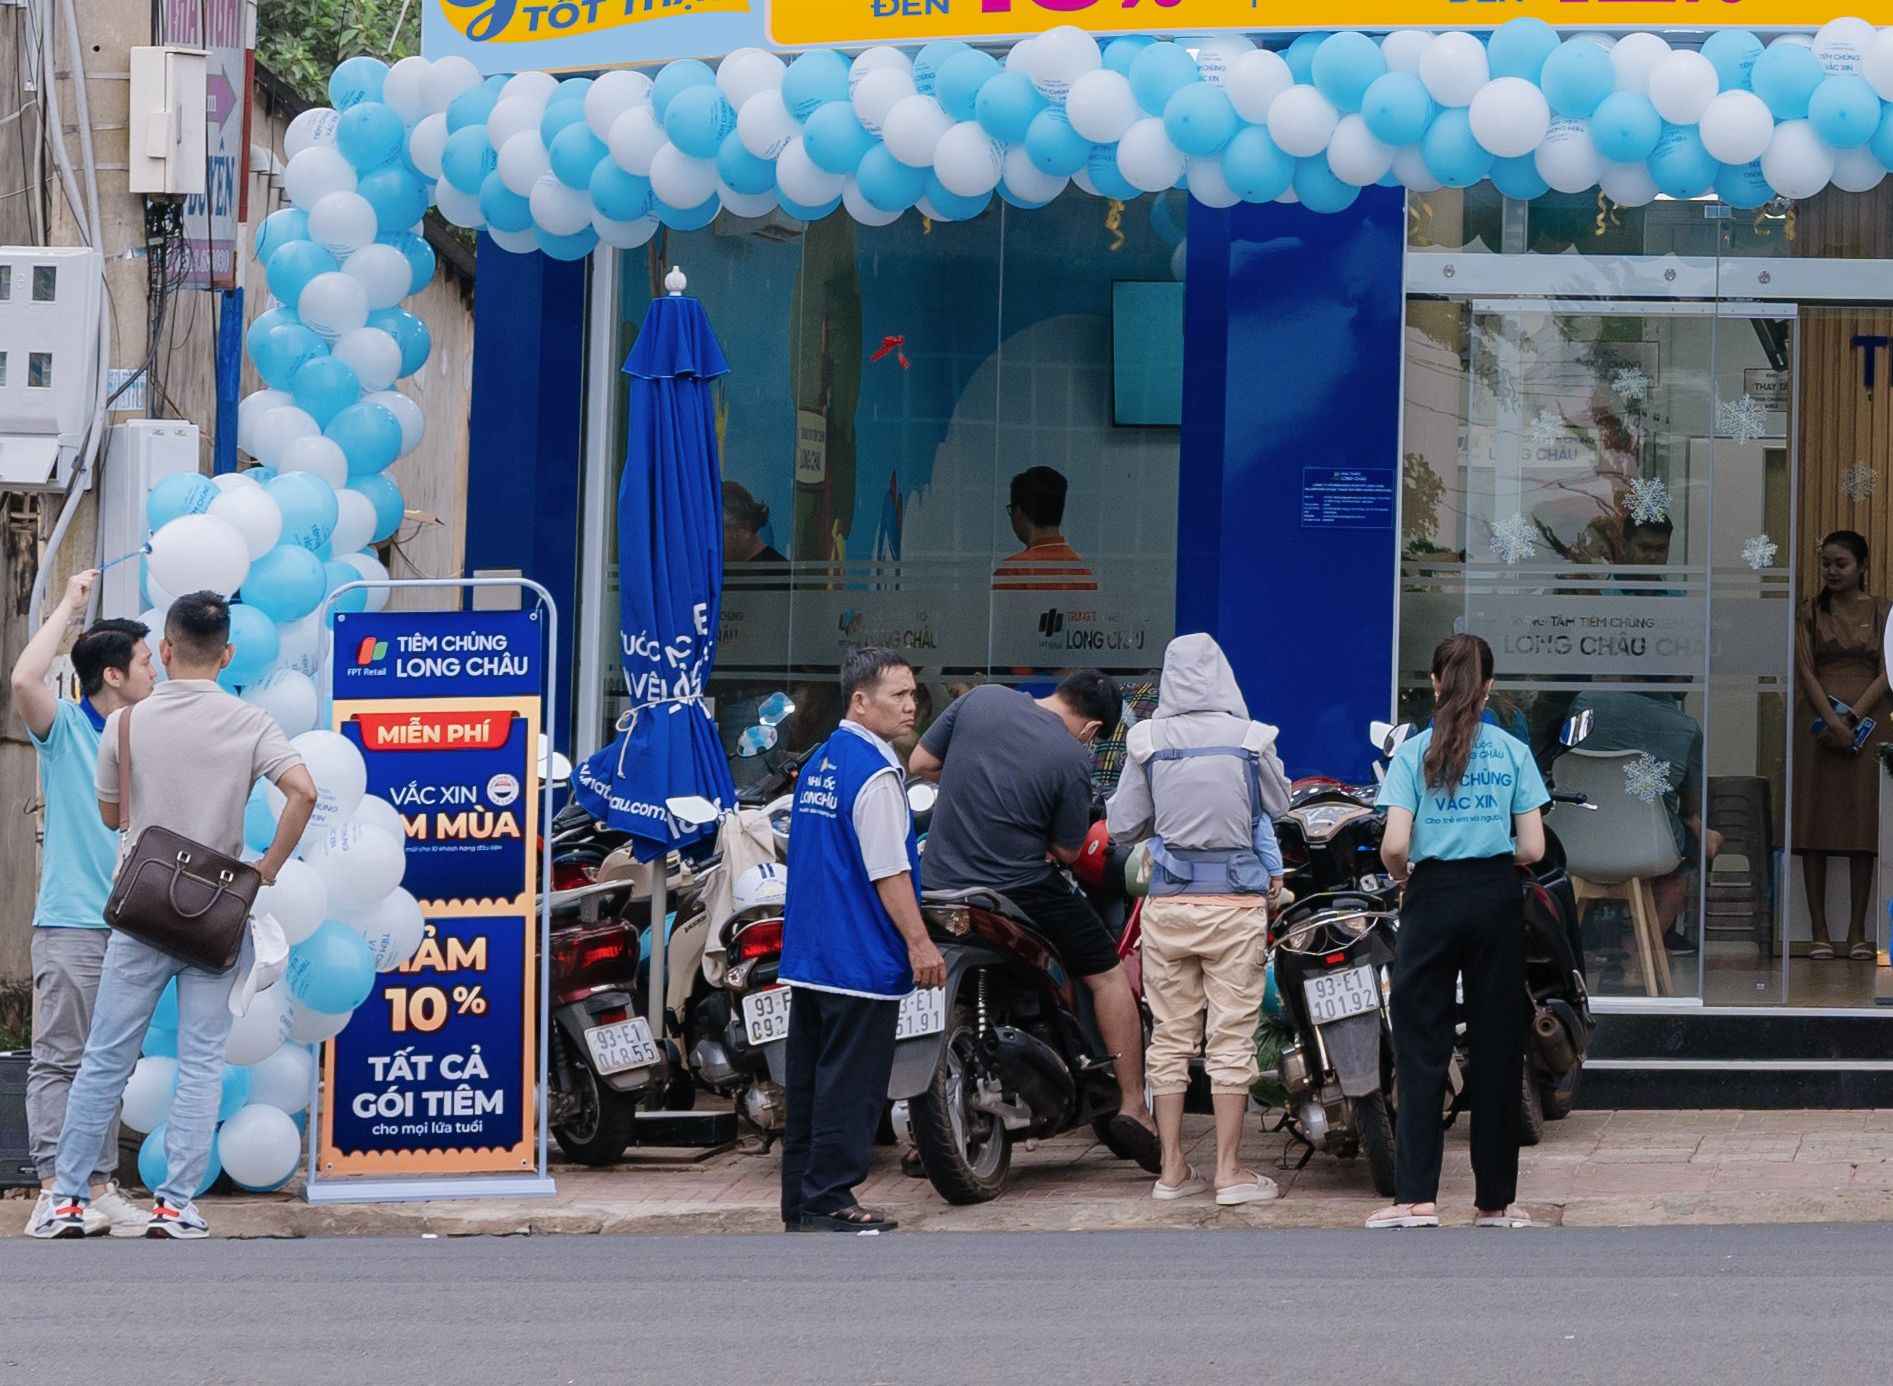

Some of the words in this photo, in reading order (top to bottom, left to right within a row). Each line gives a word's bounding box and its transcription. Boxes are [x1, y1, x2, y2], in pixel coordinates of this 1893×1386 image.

[378, 717, 440, 744] MIỄN
[447, 719, 491, 742] PHÍ
[389, 780, 436, 805] VẮC
[440, 786, 476, 803] XIN
[437, 805, 520, 839] MÙA
[1316, 970, 1362, 998] 93-E1
[1315, 989, 1374, 1019] 101.92
[597, 1025, 642, 1048] 93-E1
[368, 1046, 433, 1081] TẤT
[439, 1044, 489, 1080] CẢ
[352, 1086, 414, 1119] GÓI
[422, 1084, 503, 1116] TIÊM
